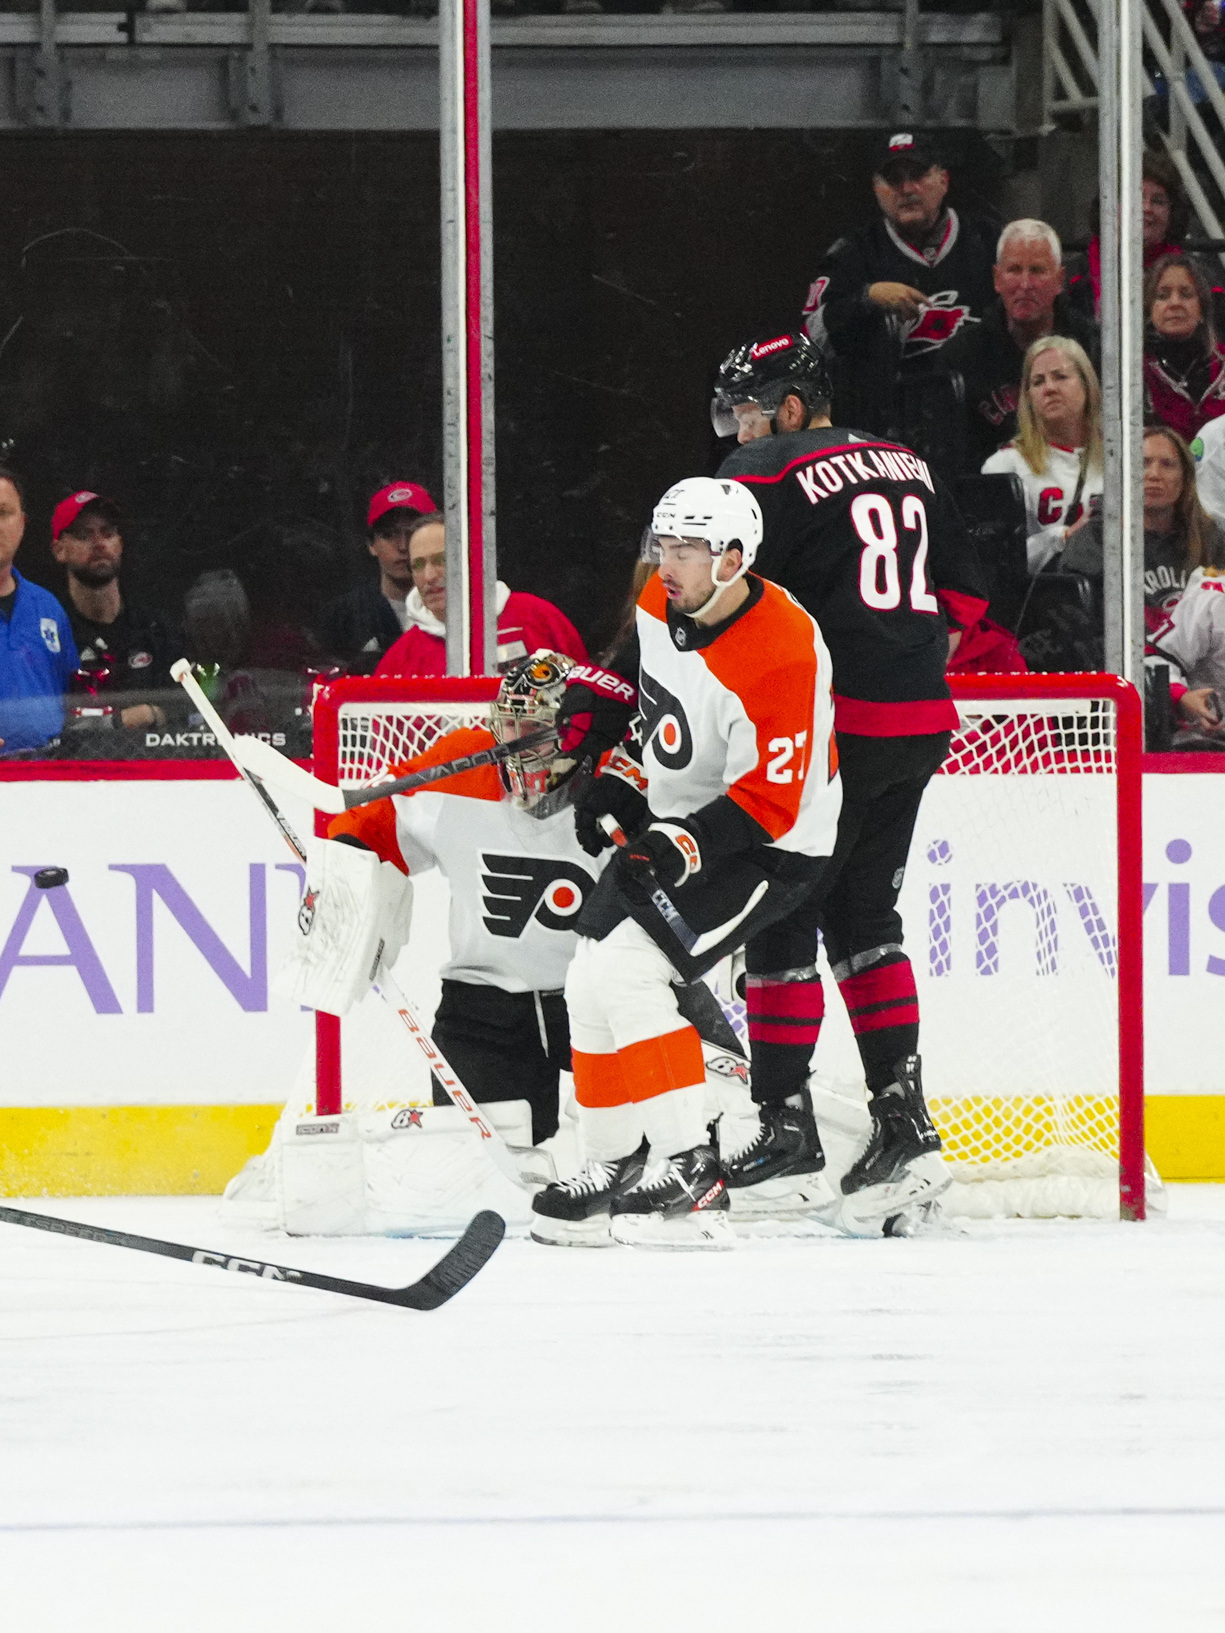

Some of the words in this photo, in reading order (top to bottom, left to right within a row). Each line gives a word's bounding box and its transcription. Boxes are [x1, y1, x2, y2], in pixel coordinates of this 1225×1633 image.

[753, 337, 790, 358] Lenovo
[850, 493, 939, 614] 82
[565, 664, 636, 701] AUER
[697, 1182, 723, 1209] CCM
